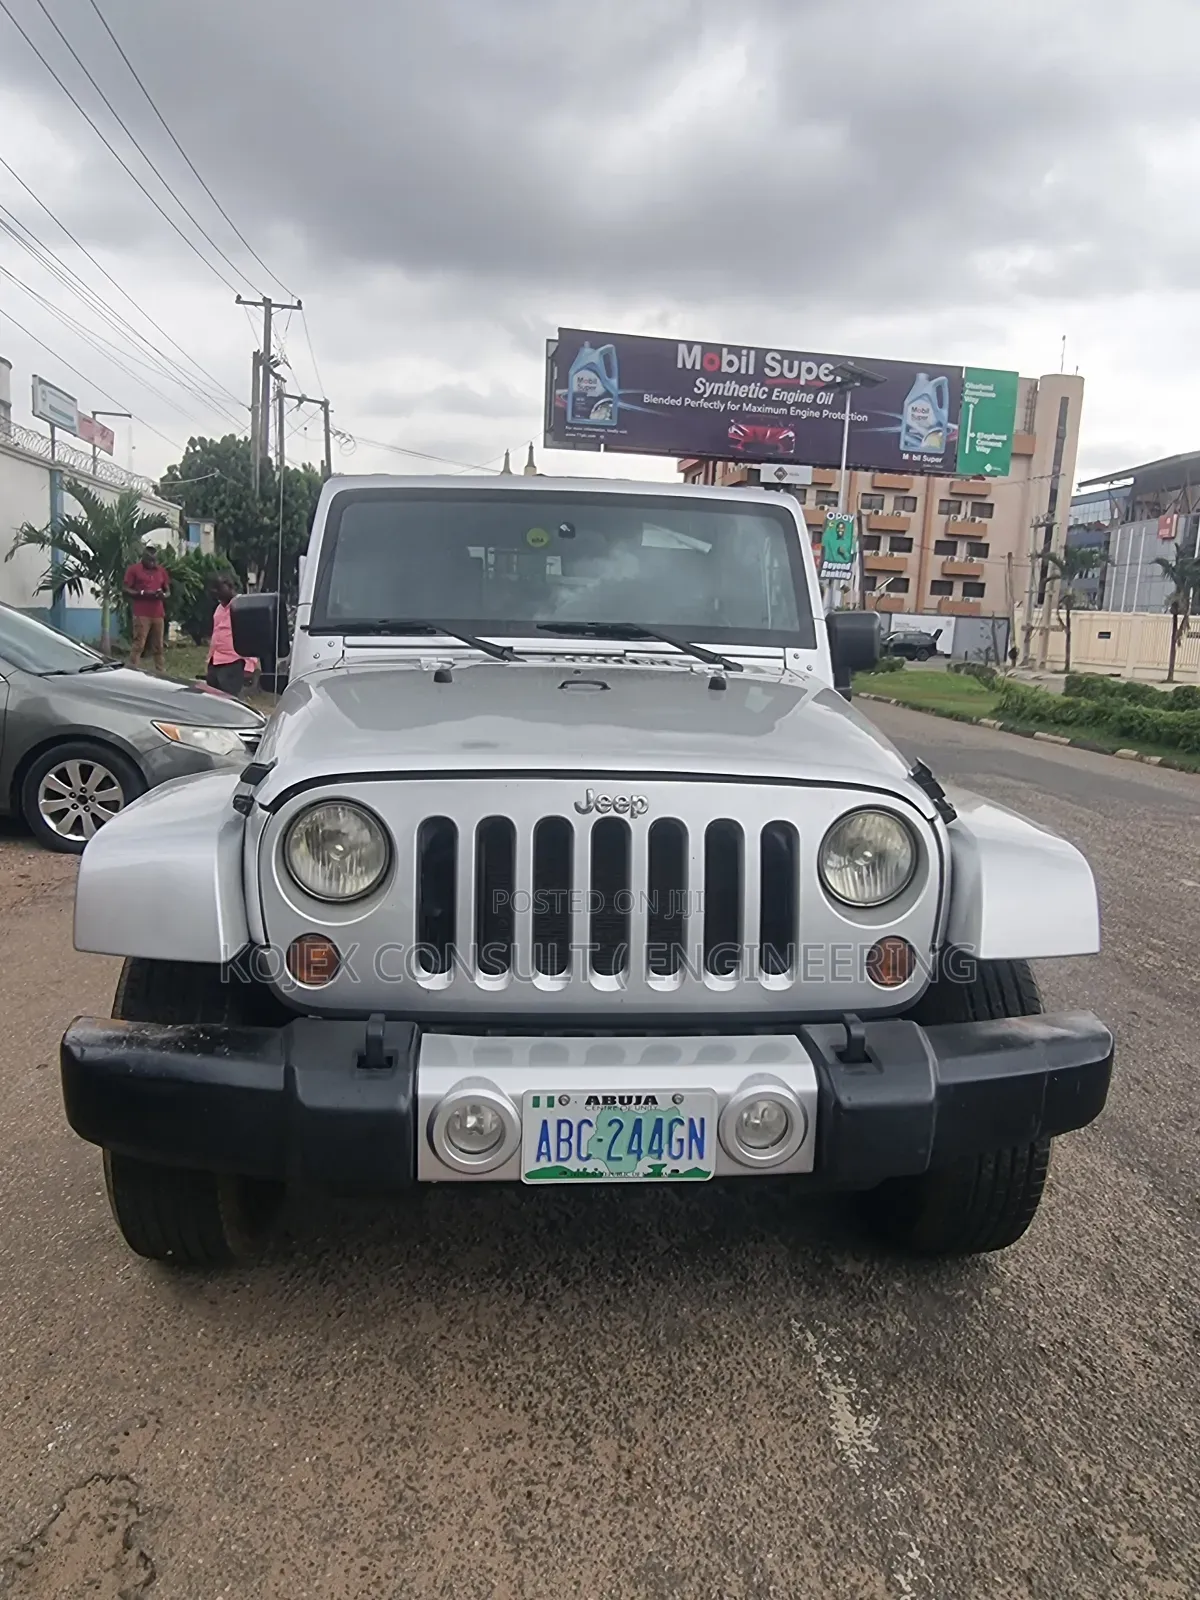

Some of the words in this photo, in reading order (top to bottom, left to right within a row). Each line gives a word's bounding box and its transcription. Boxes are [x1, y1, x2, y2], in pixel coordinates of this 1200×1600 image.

[677, 343, 755, 375] Mobil
[577, 376, 598, 385] Mobil
[577, 384, 597, 392] Super
[694, 377, 769, 399] Synthetic
[772, 388, 814, 405] Engine
[816, 391, 834, 405] Oil
[643, 393, 682, 407] Blended
[684, 397, 726, 412] Perfectly
[726, 400, 741, 411] for
[742, 403, 788, 416] Maximum
[790, 407, 821, 420] Engine
[911, 406, 930, 414] Mobil
[902, 453, 922, 461] Mbil
[922, 454, 943, 463] Super
[827, 512, 854, 522] OPay
[823, 561, 851, 570] Beyond
[820, 570, 851, 579] Banking
[574, 788, 649, 819] Jeep
[584, 1095, 659, 1106] ABUJA
[536, 1117, 705, 1162] ABC-244GN
